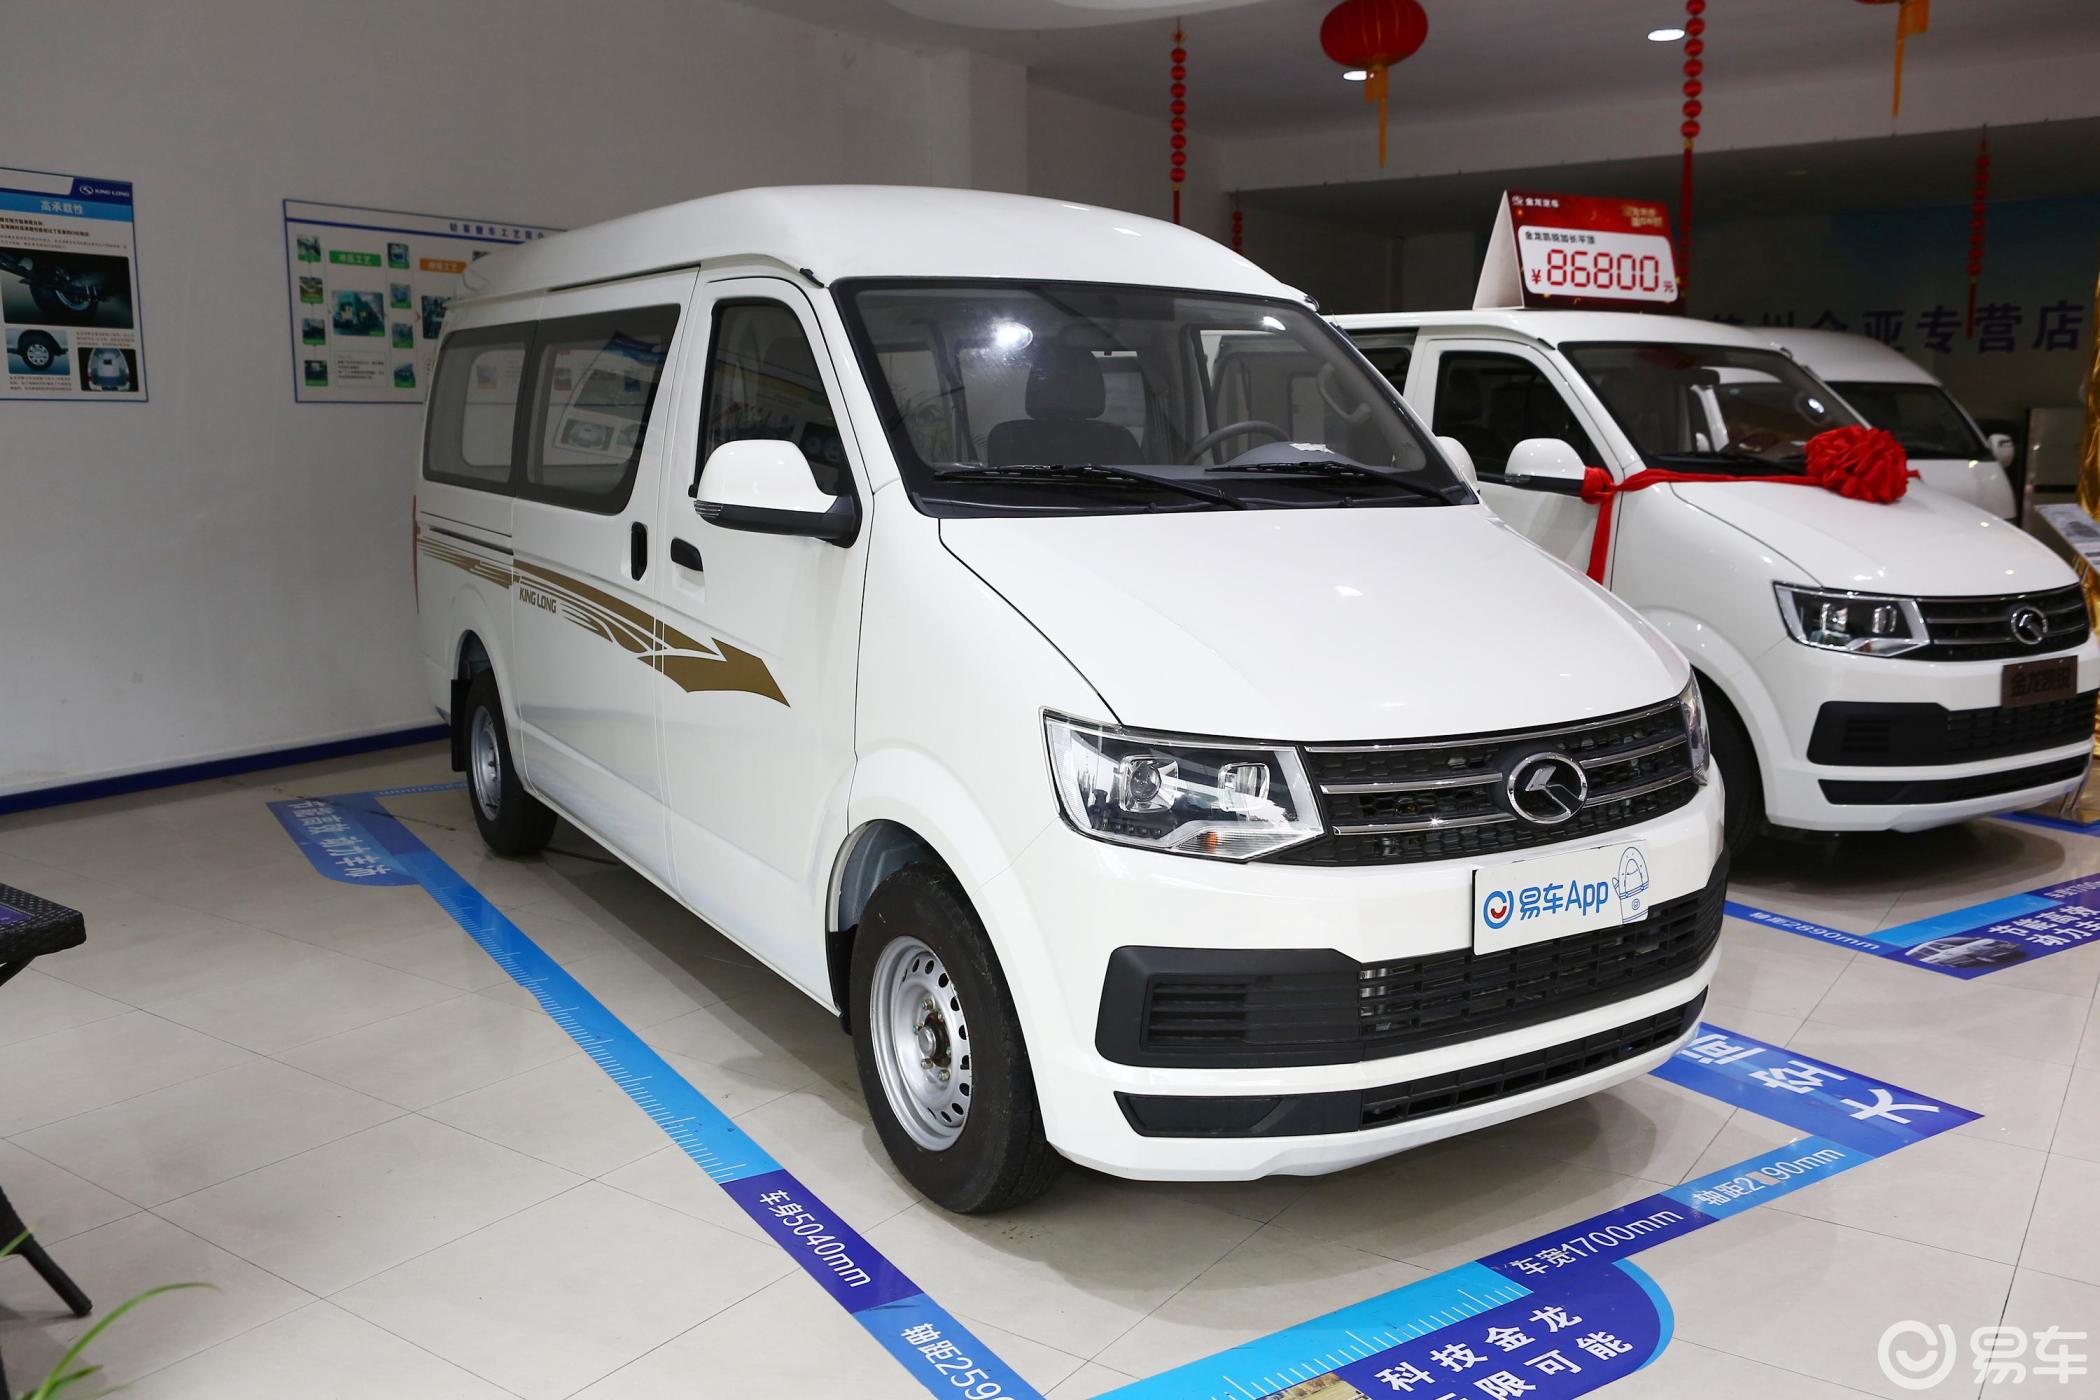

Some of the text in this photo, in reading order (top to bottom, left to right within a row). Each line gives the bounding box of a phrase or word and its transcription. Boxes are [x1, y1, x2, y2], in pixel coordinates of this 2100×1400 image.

[519, 587, 557, 614] KING LONG
[1519, 880, 1609, 921] 易车App
[1692, 1148, 1846, 1207] 轴距290mm
[759, 1190, 871, 1288] 车身5040mm
[1513, 1208, 1685, 1279] 车宽1700mm
[901, 1323, 1014, 1400] 轴距259
[1374, 1303, 1583, 1394] 科技金龙
[1430, 1330, 1634, 1400] 限可能
